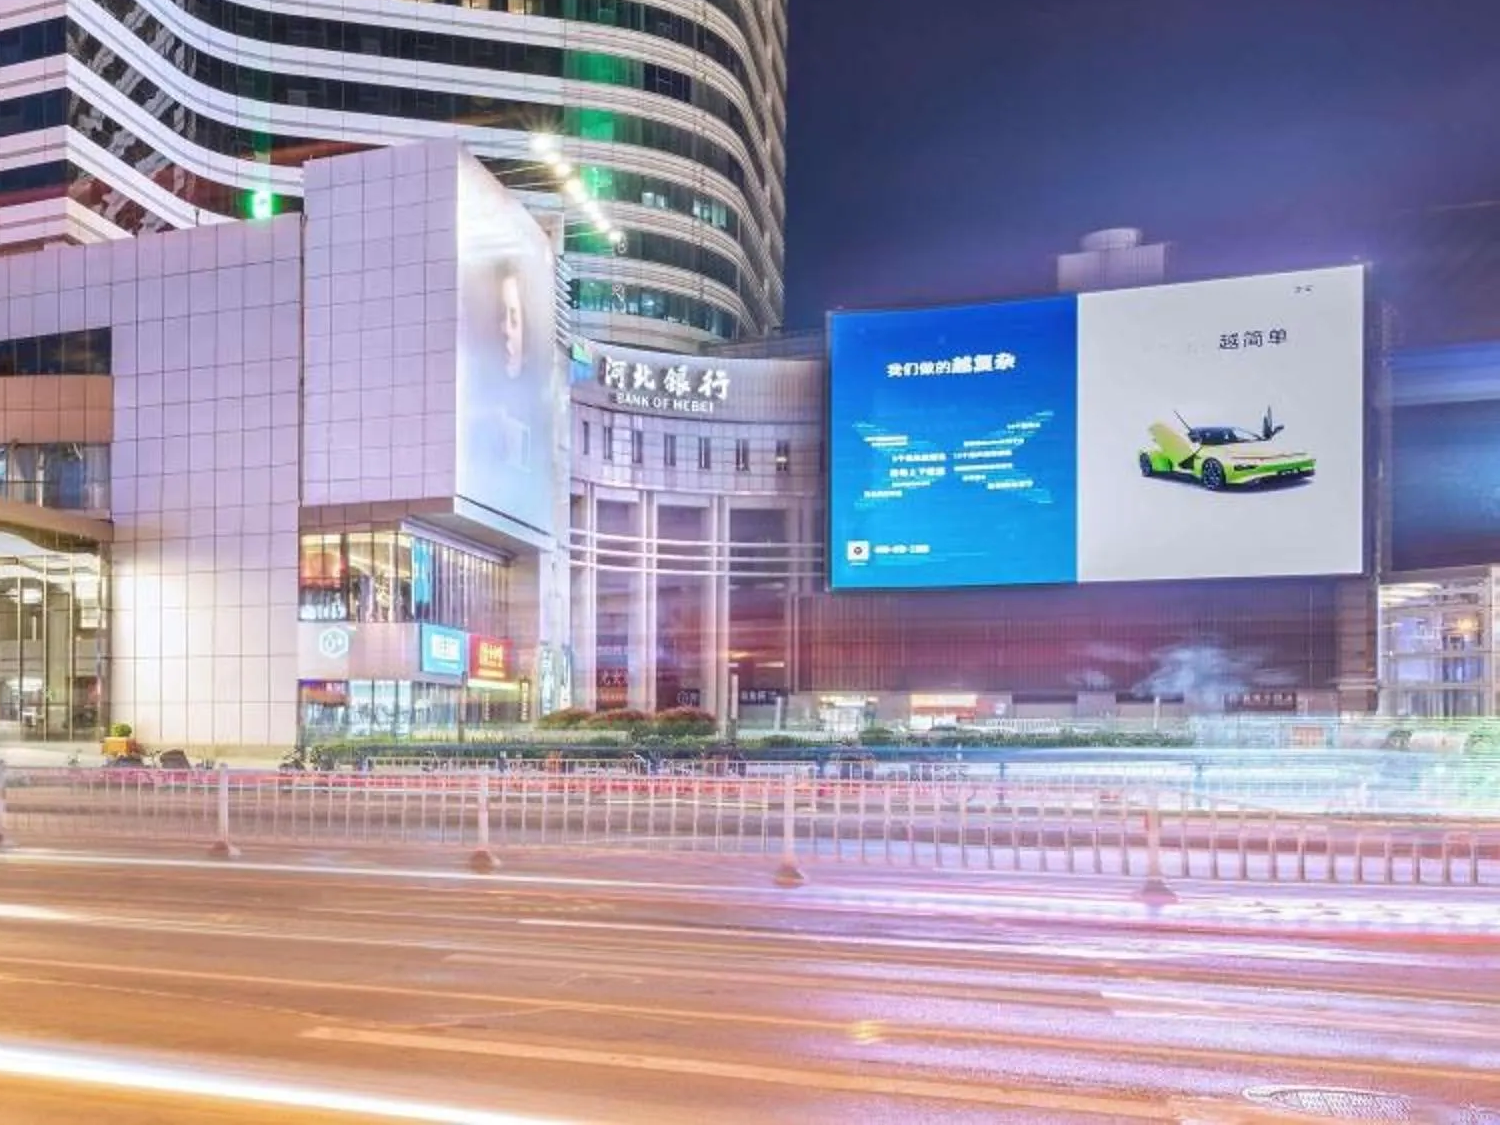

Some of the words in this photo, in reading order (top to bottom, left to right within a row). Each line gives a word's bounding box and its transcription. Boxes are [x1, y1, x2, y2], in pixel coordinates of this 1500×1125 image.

[1219, 328, 1287, 350] 越简单
[604, 355, 731, 400] 河北银行
[616, 391, 649, 408] BANK
[653, 397, 671, 409] OF
[673, 398, 714, 413] HEBEI
